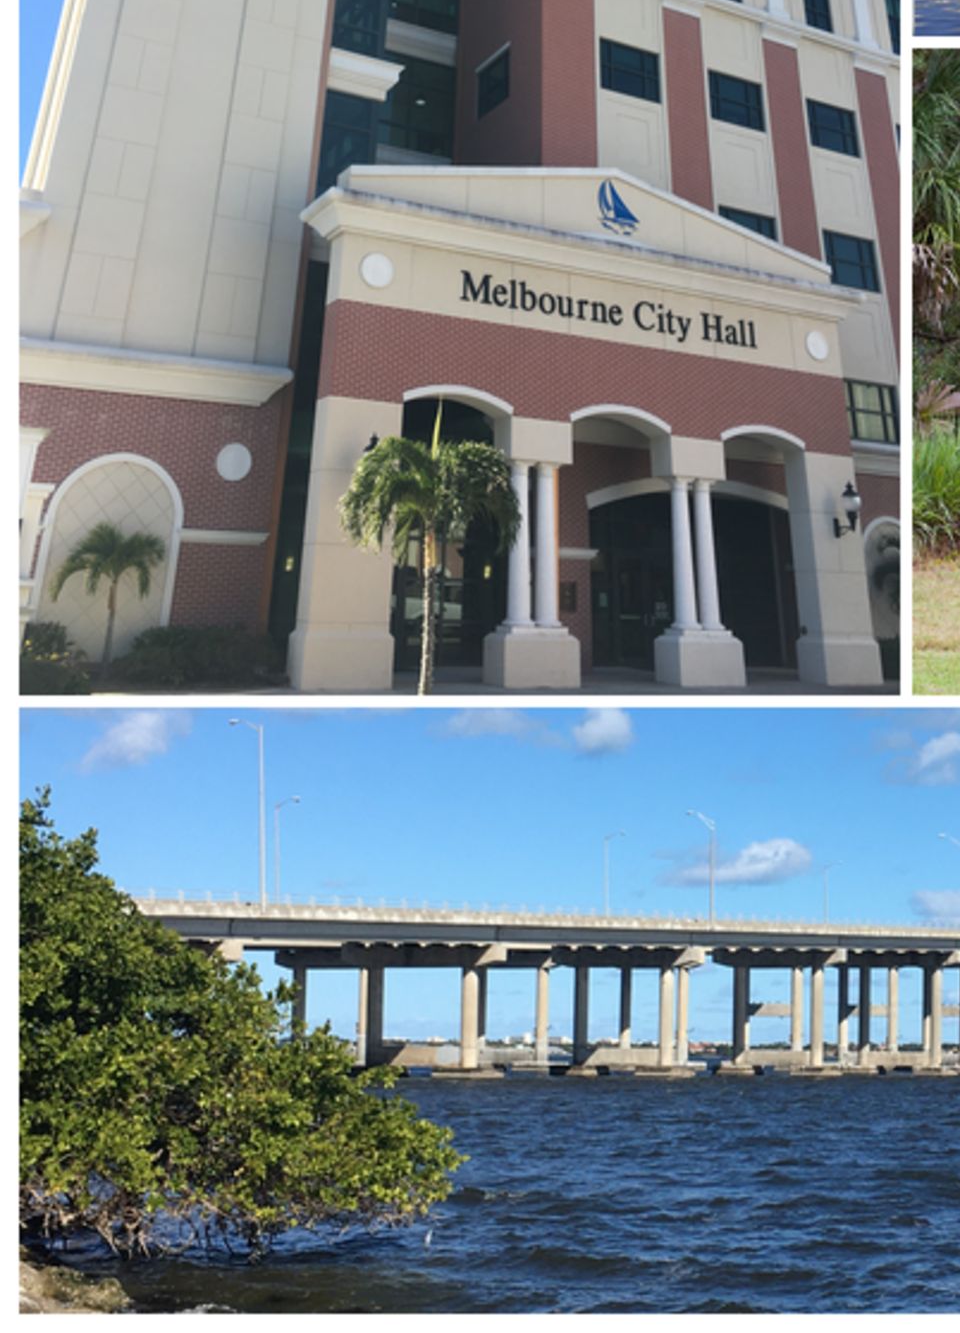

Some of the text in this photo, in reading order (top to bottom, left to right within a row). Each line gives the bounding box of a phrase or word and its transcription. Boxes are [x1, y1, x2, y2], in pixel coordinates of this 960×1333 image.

[460, 270, 757, 349] Melbourne City Hall
